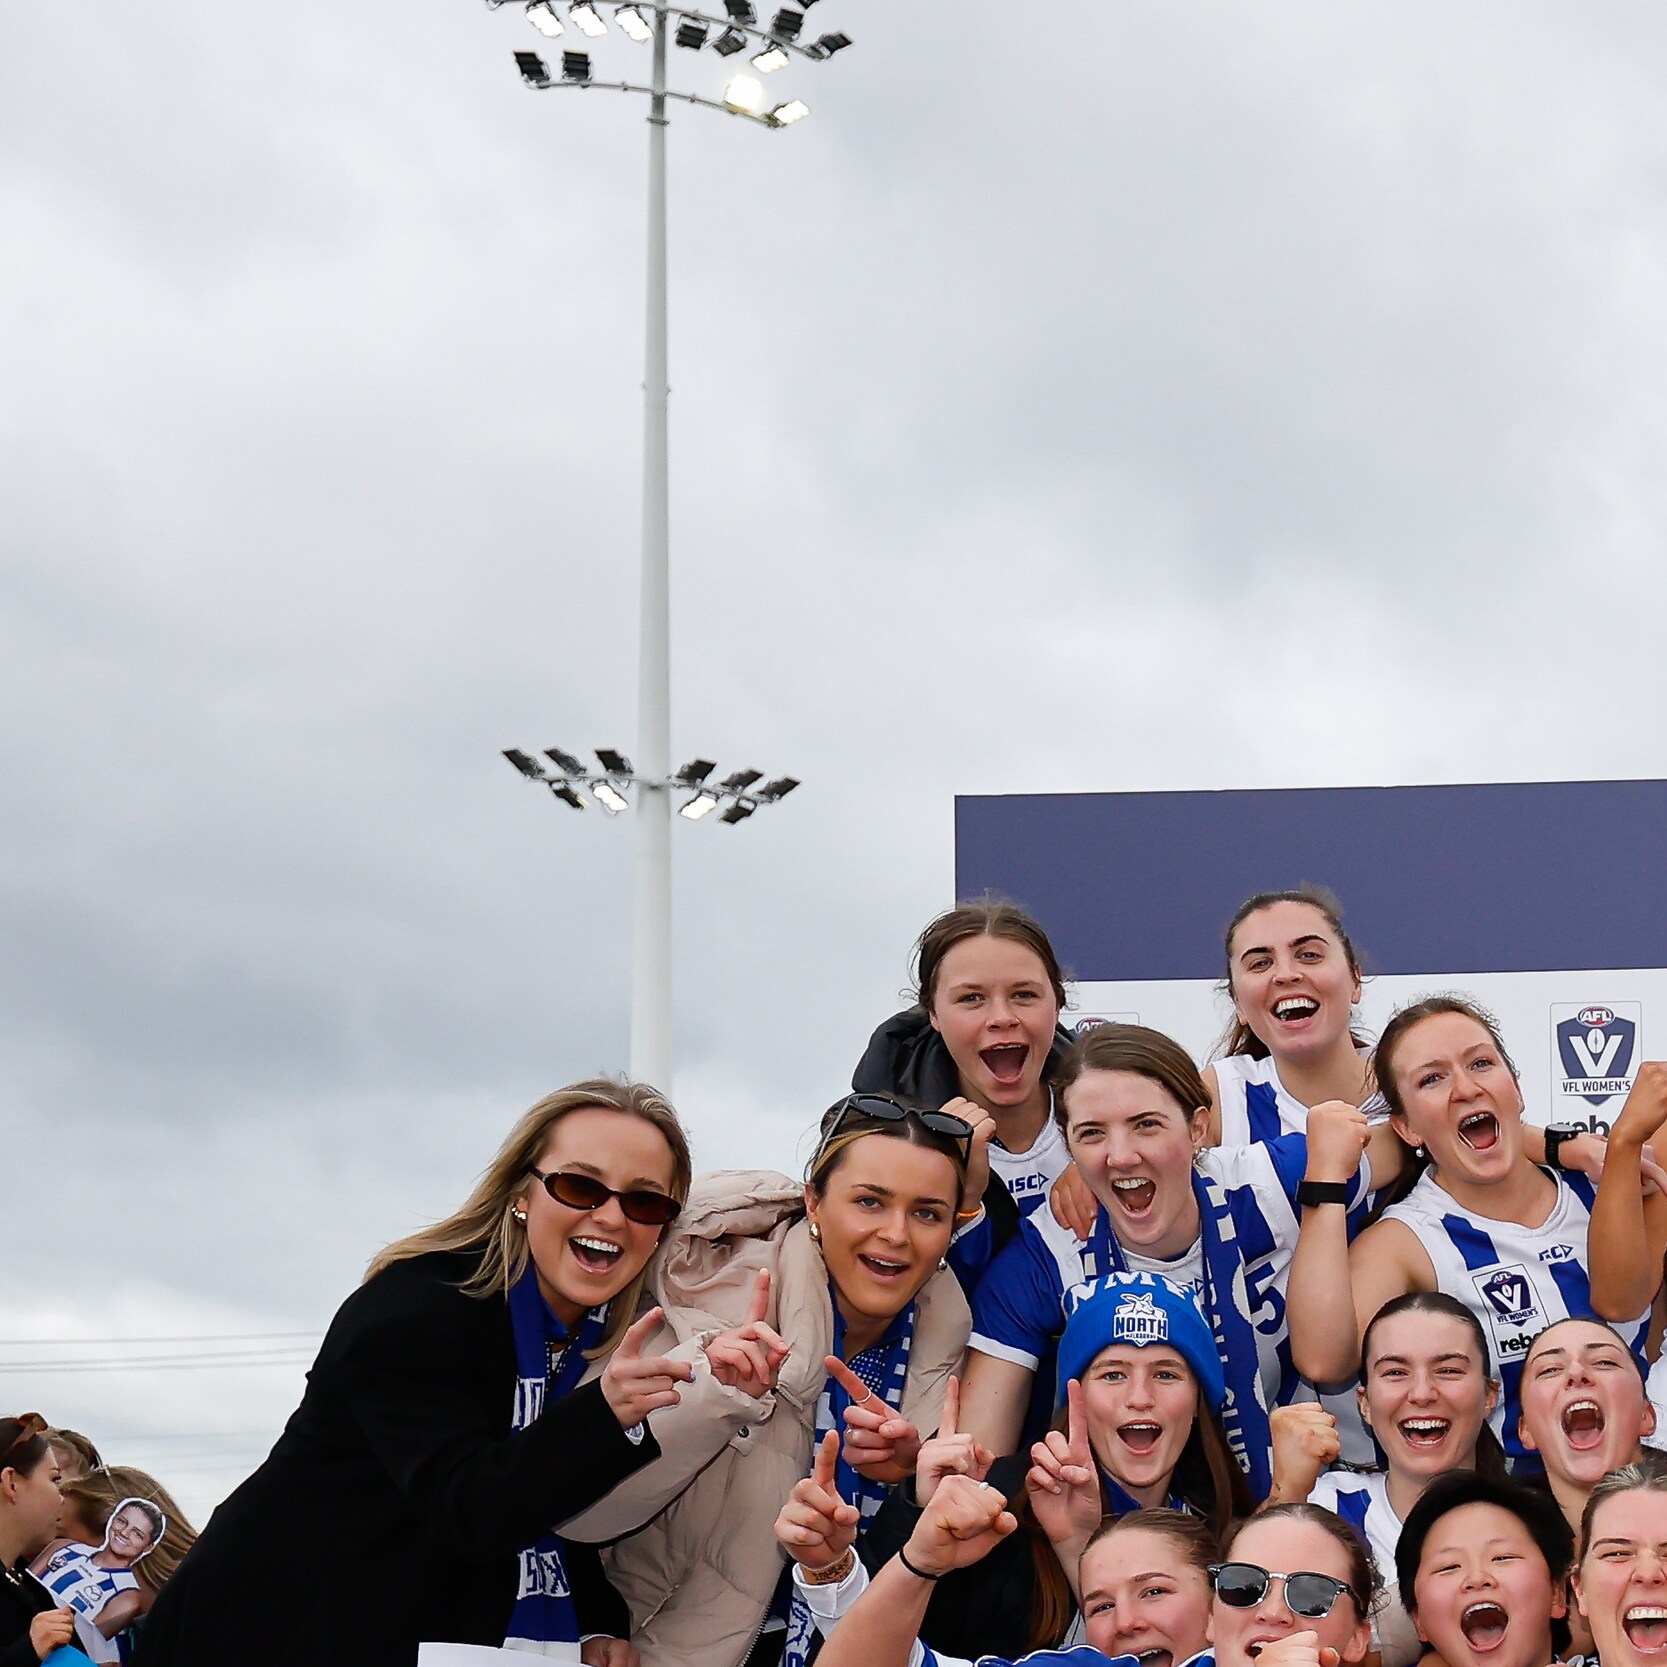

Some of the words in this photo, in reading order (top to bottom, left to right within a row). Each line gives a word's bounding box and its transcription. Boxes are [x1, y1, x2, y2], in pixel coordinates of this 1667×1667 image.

[1579, 1009, 1612, 1024] AFL
[1562, 1081, 1581, 1092] VFL
[1583, 1081, 1631, 1092] WOMEN'S
[1115, 1315, 1169, 1338] NORTH
